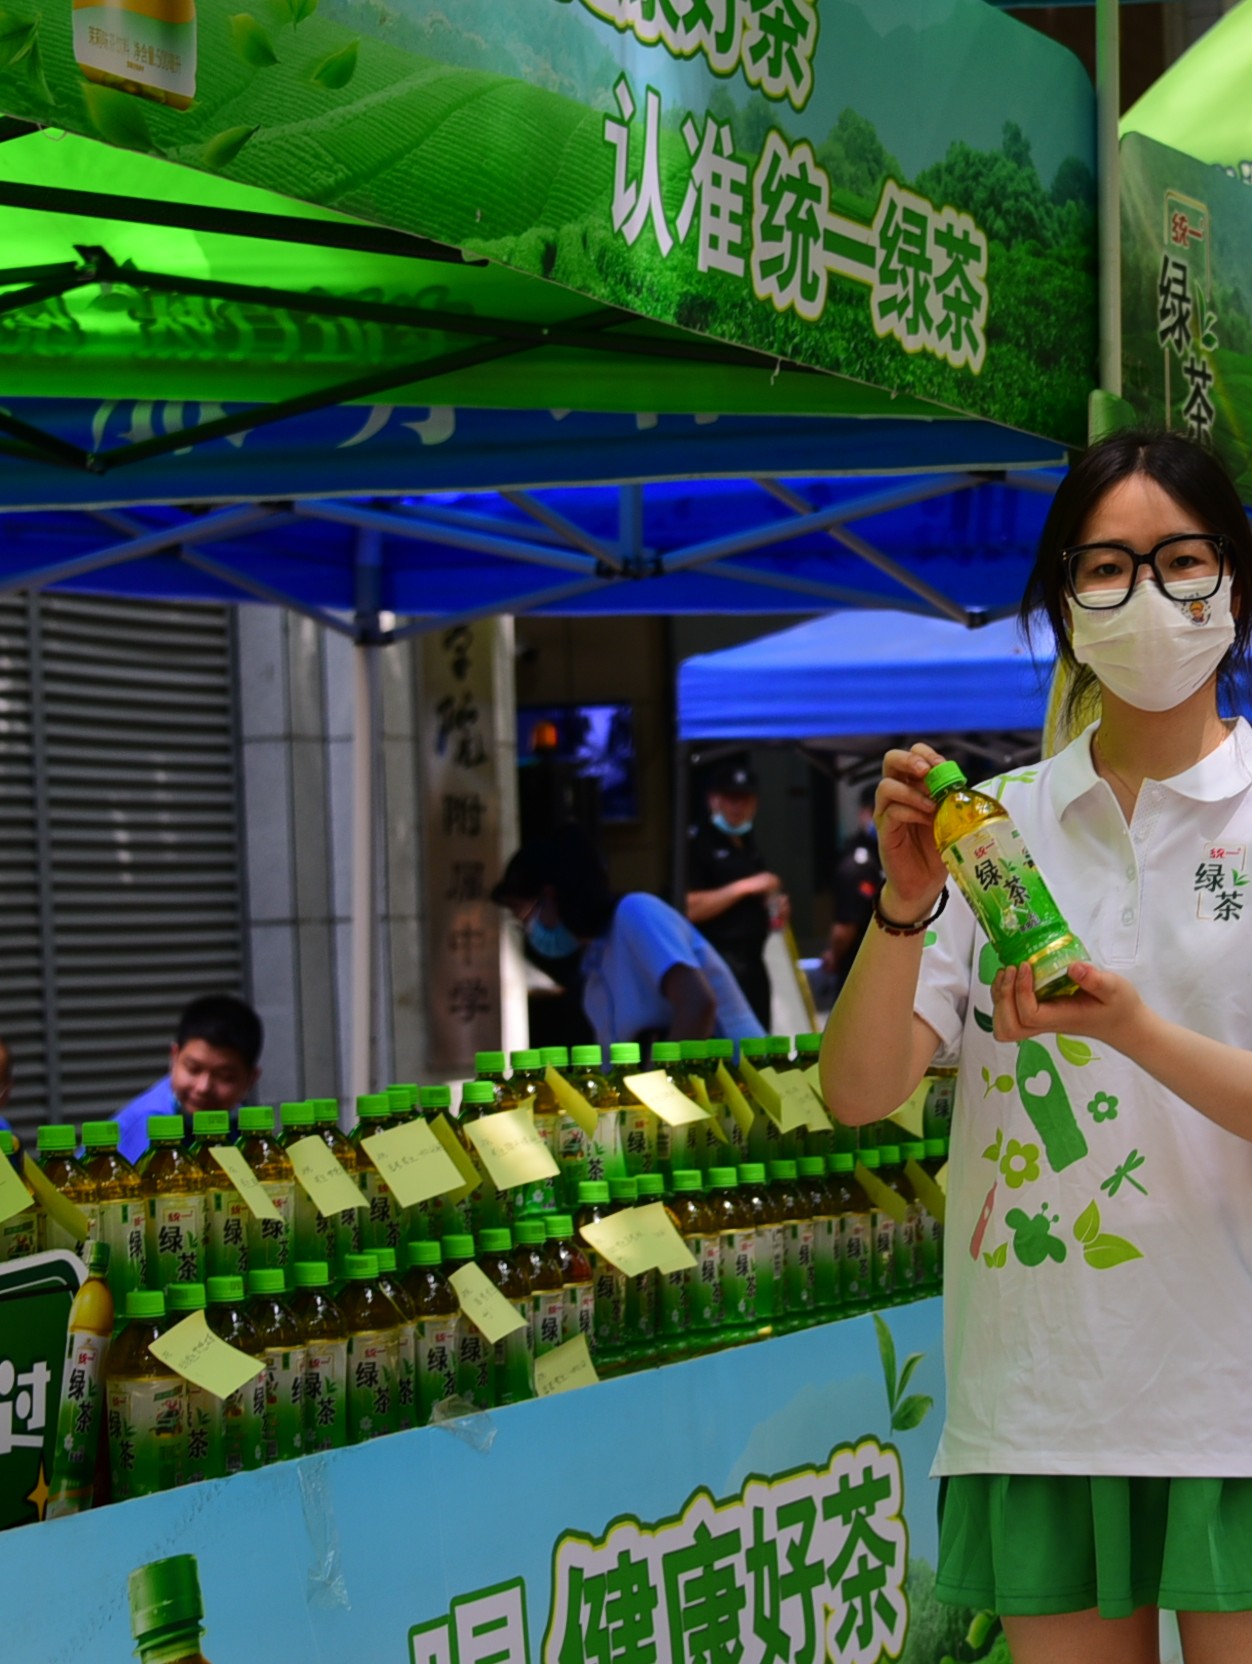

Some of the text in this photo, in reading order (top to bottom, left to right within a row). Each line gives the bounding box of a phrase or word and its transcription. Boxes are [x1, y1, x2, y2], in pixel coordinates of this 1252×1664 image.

[604, 72, 988, 374] 认准统一绿茶
[1171, 212, 1203, 247] 统一
[1158, 253, 1215, 445] 绿茶
[974, 838, 997, 859] 统一
[975, 859, 1031, 908] 绿茶
[1194, 863, 1244, 921] 绿茶
[159, 1225, 198, 1281] 绿茶
[67, 1367, 97, 1434] 绿茶
[305, 1372, 337, 1426] 绿茶
[355, 1361, 391, 1415] 绿茶
[109, 1410, 136, 1470] 绿茶
